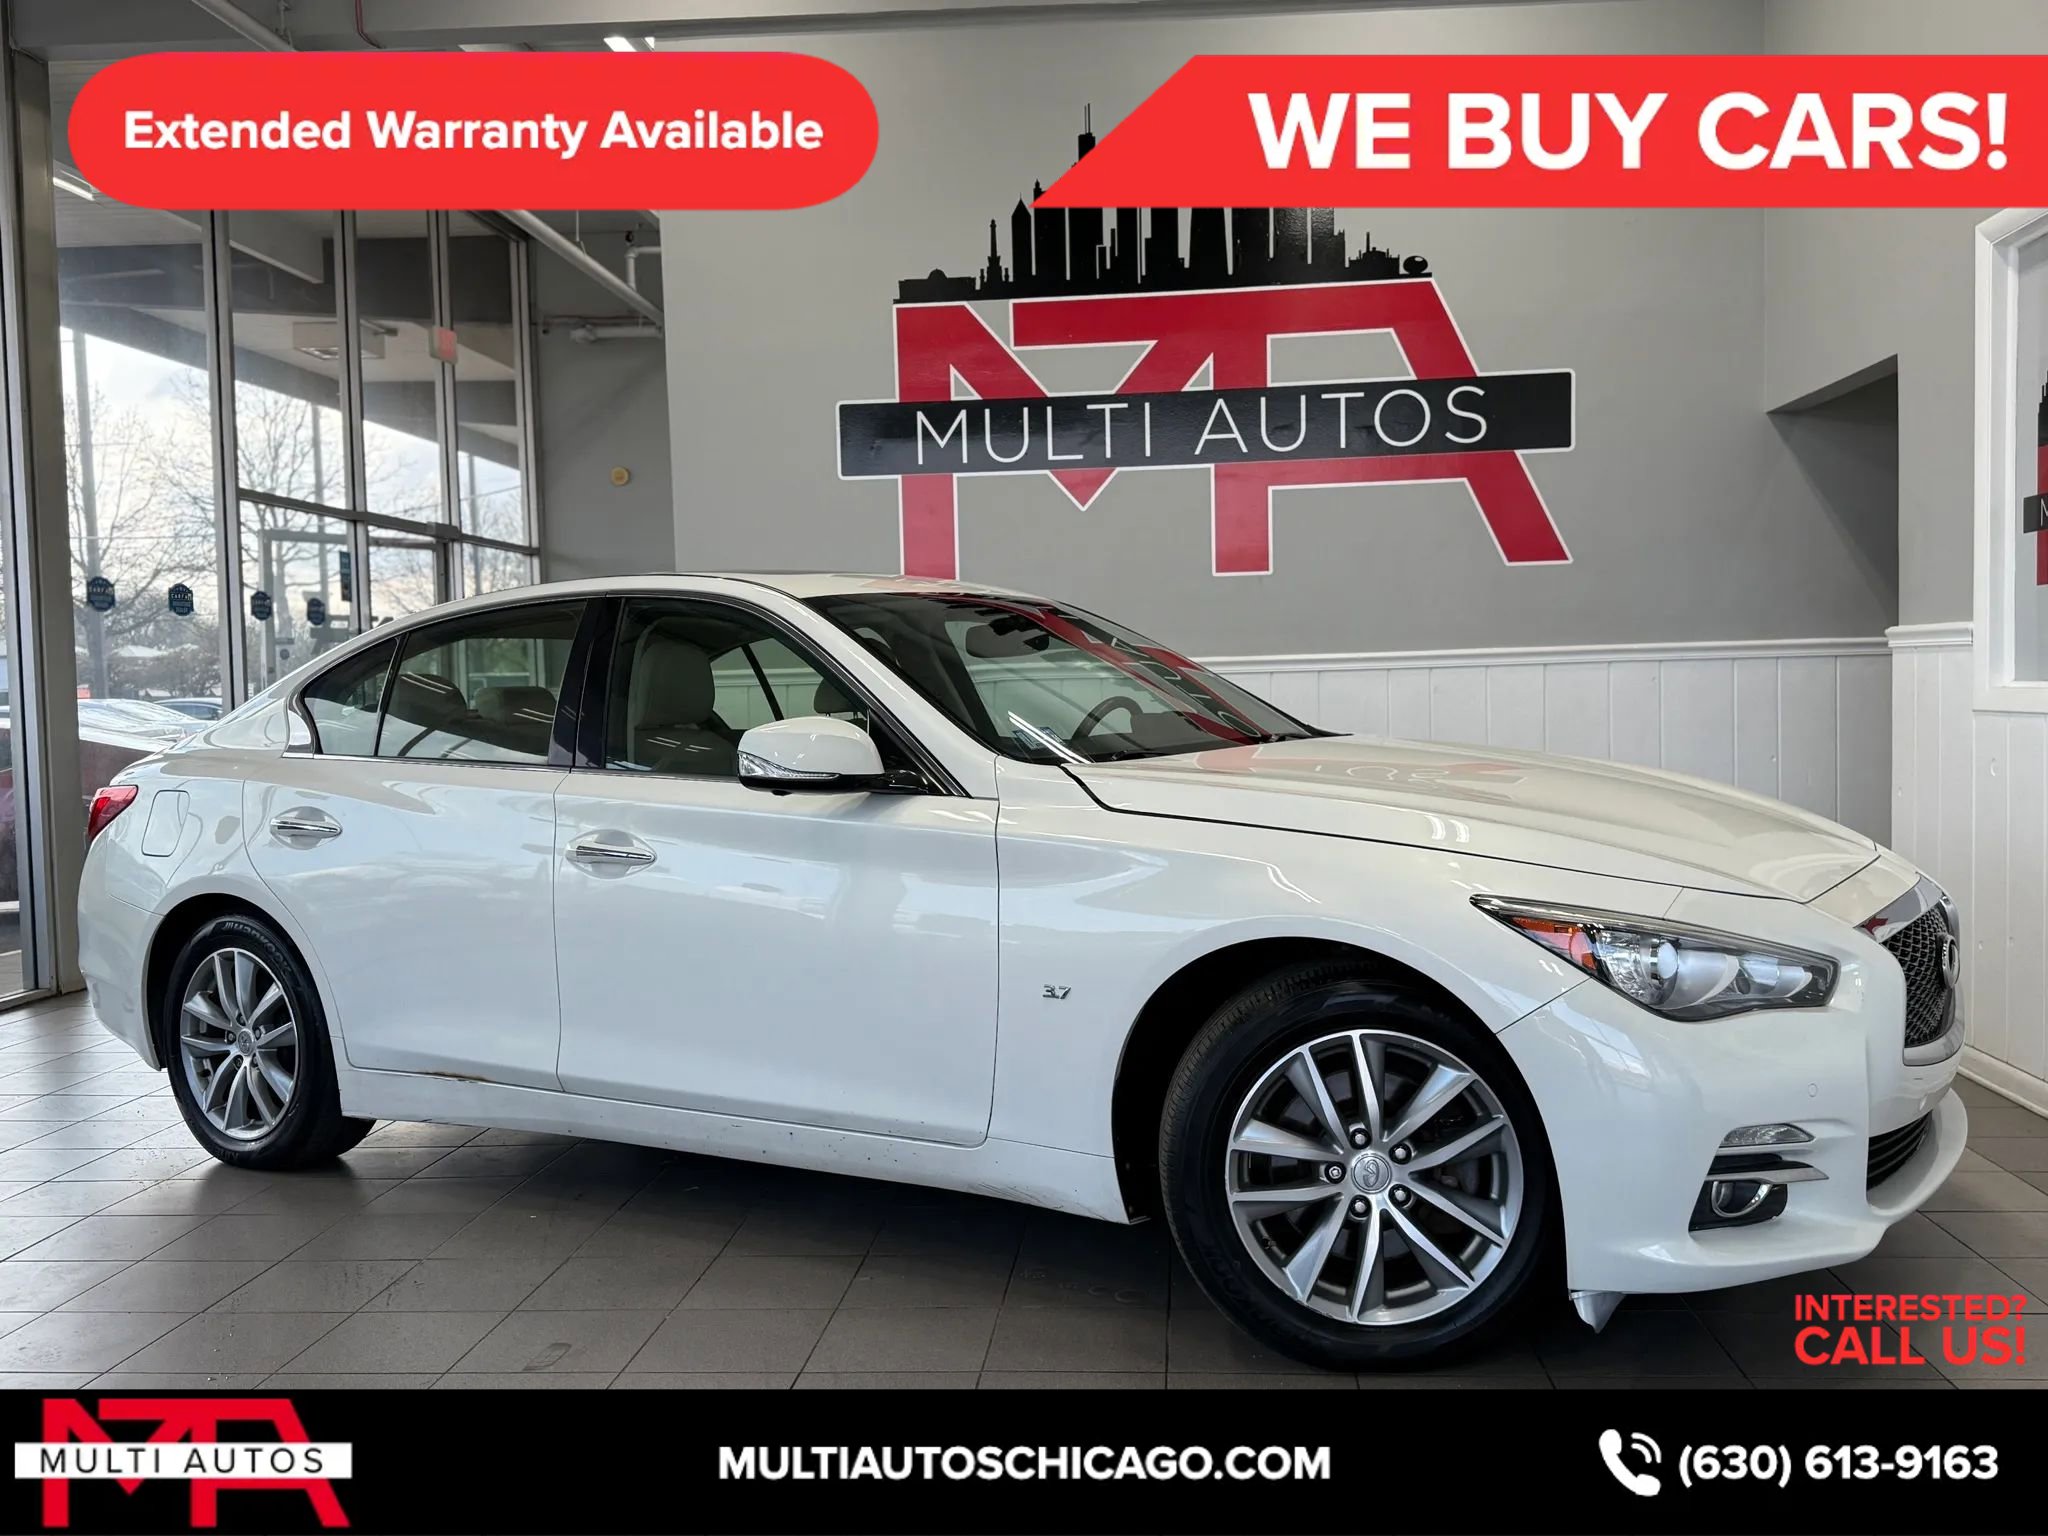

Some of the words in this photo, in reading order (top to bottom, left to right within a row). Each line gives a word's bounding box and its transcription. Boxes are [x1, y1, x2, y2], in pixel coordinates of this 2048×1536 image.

[916, 402, 1152, 465] MULTI
[1194, 386, 1489, 456] AUTOS
[1042, 984, 1072, 1000] 3.7
